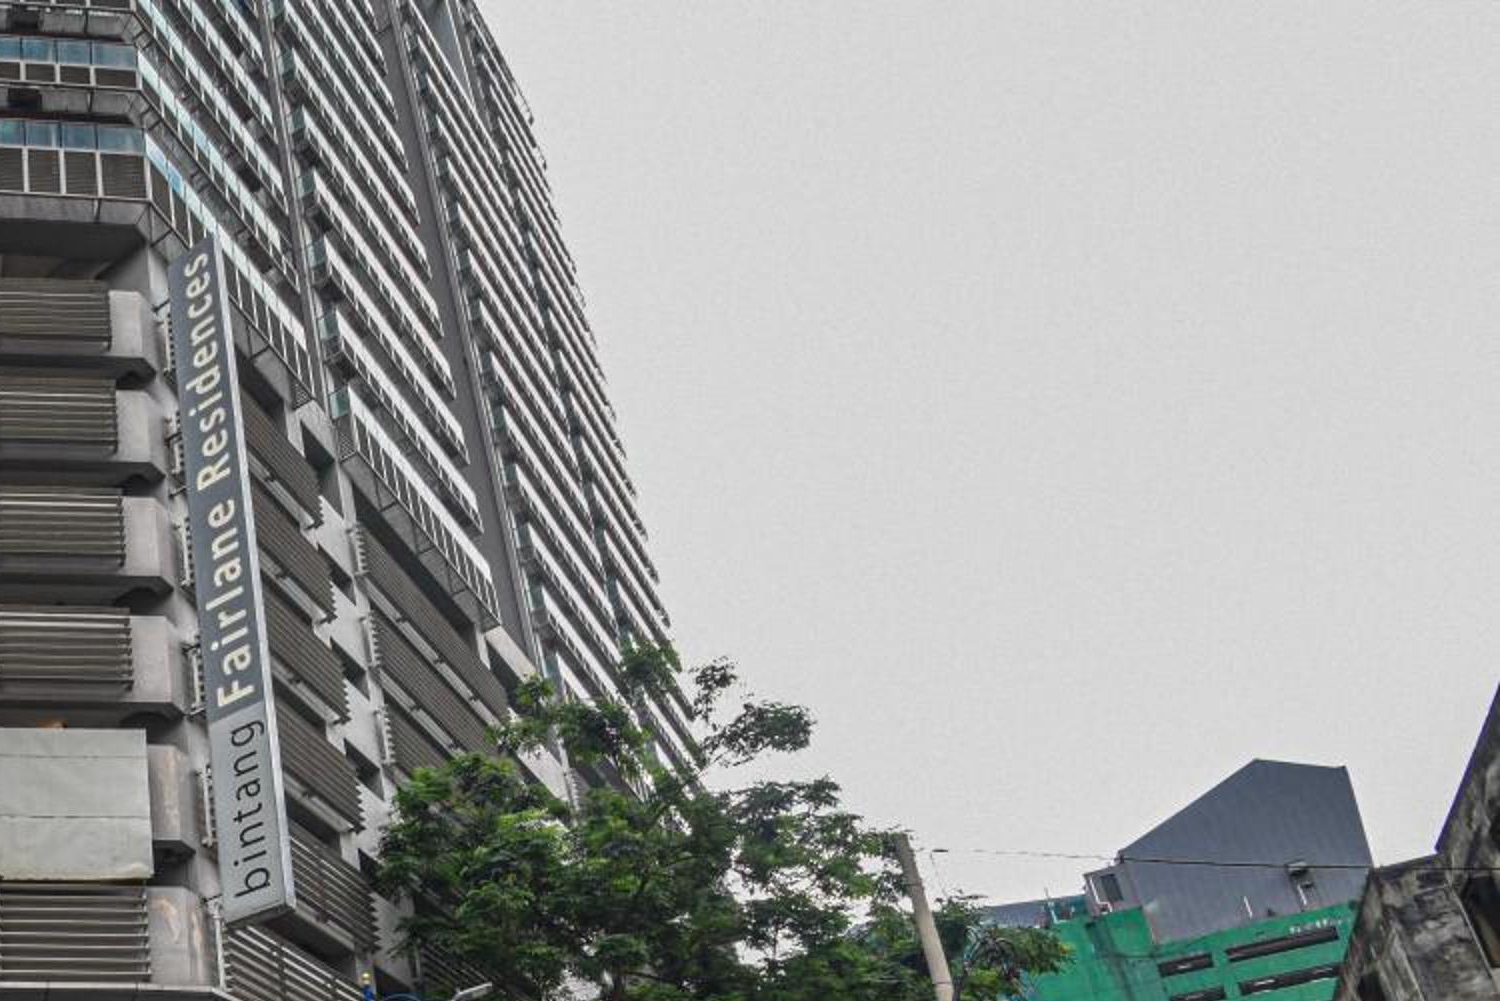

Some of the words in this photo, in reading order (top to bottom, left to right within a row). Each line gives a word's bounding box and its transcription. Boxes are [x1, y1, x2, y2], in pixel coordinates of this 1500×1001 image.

[184, 253, 231, 491] Residences
[206, 499, 254, 708] Fairlane
[233, 719, 272, 898] bintang
